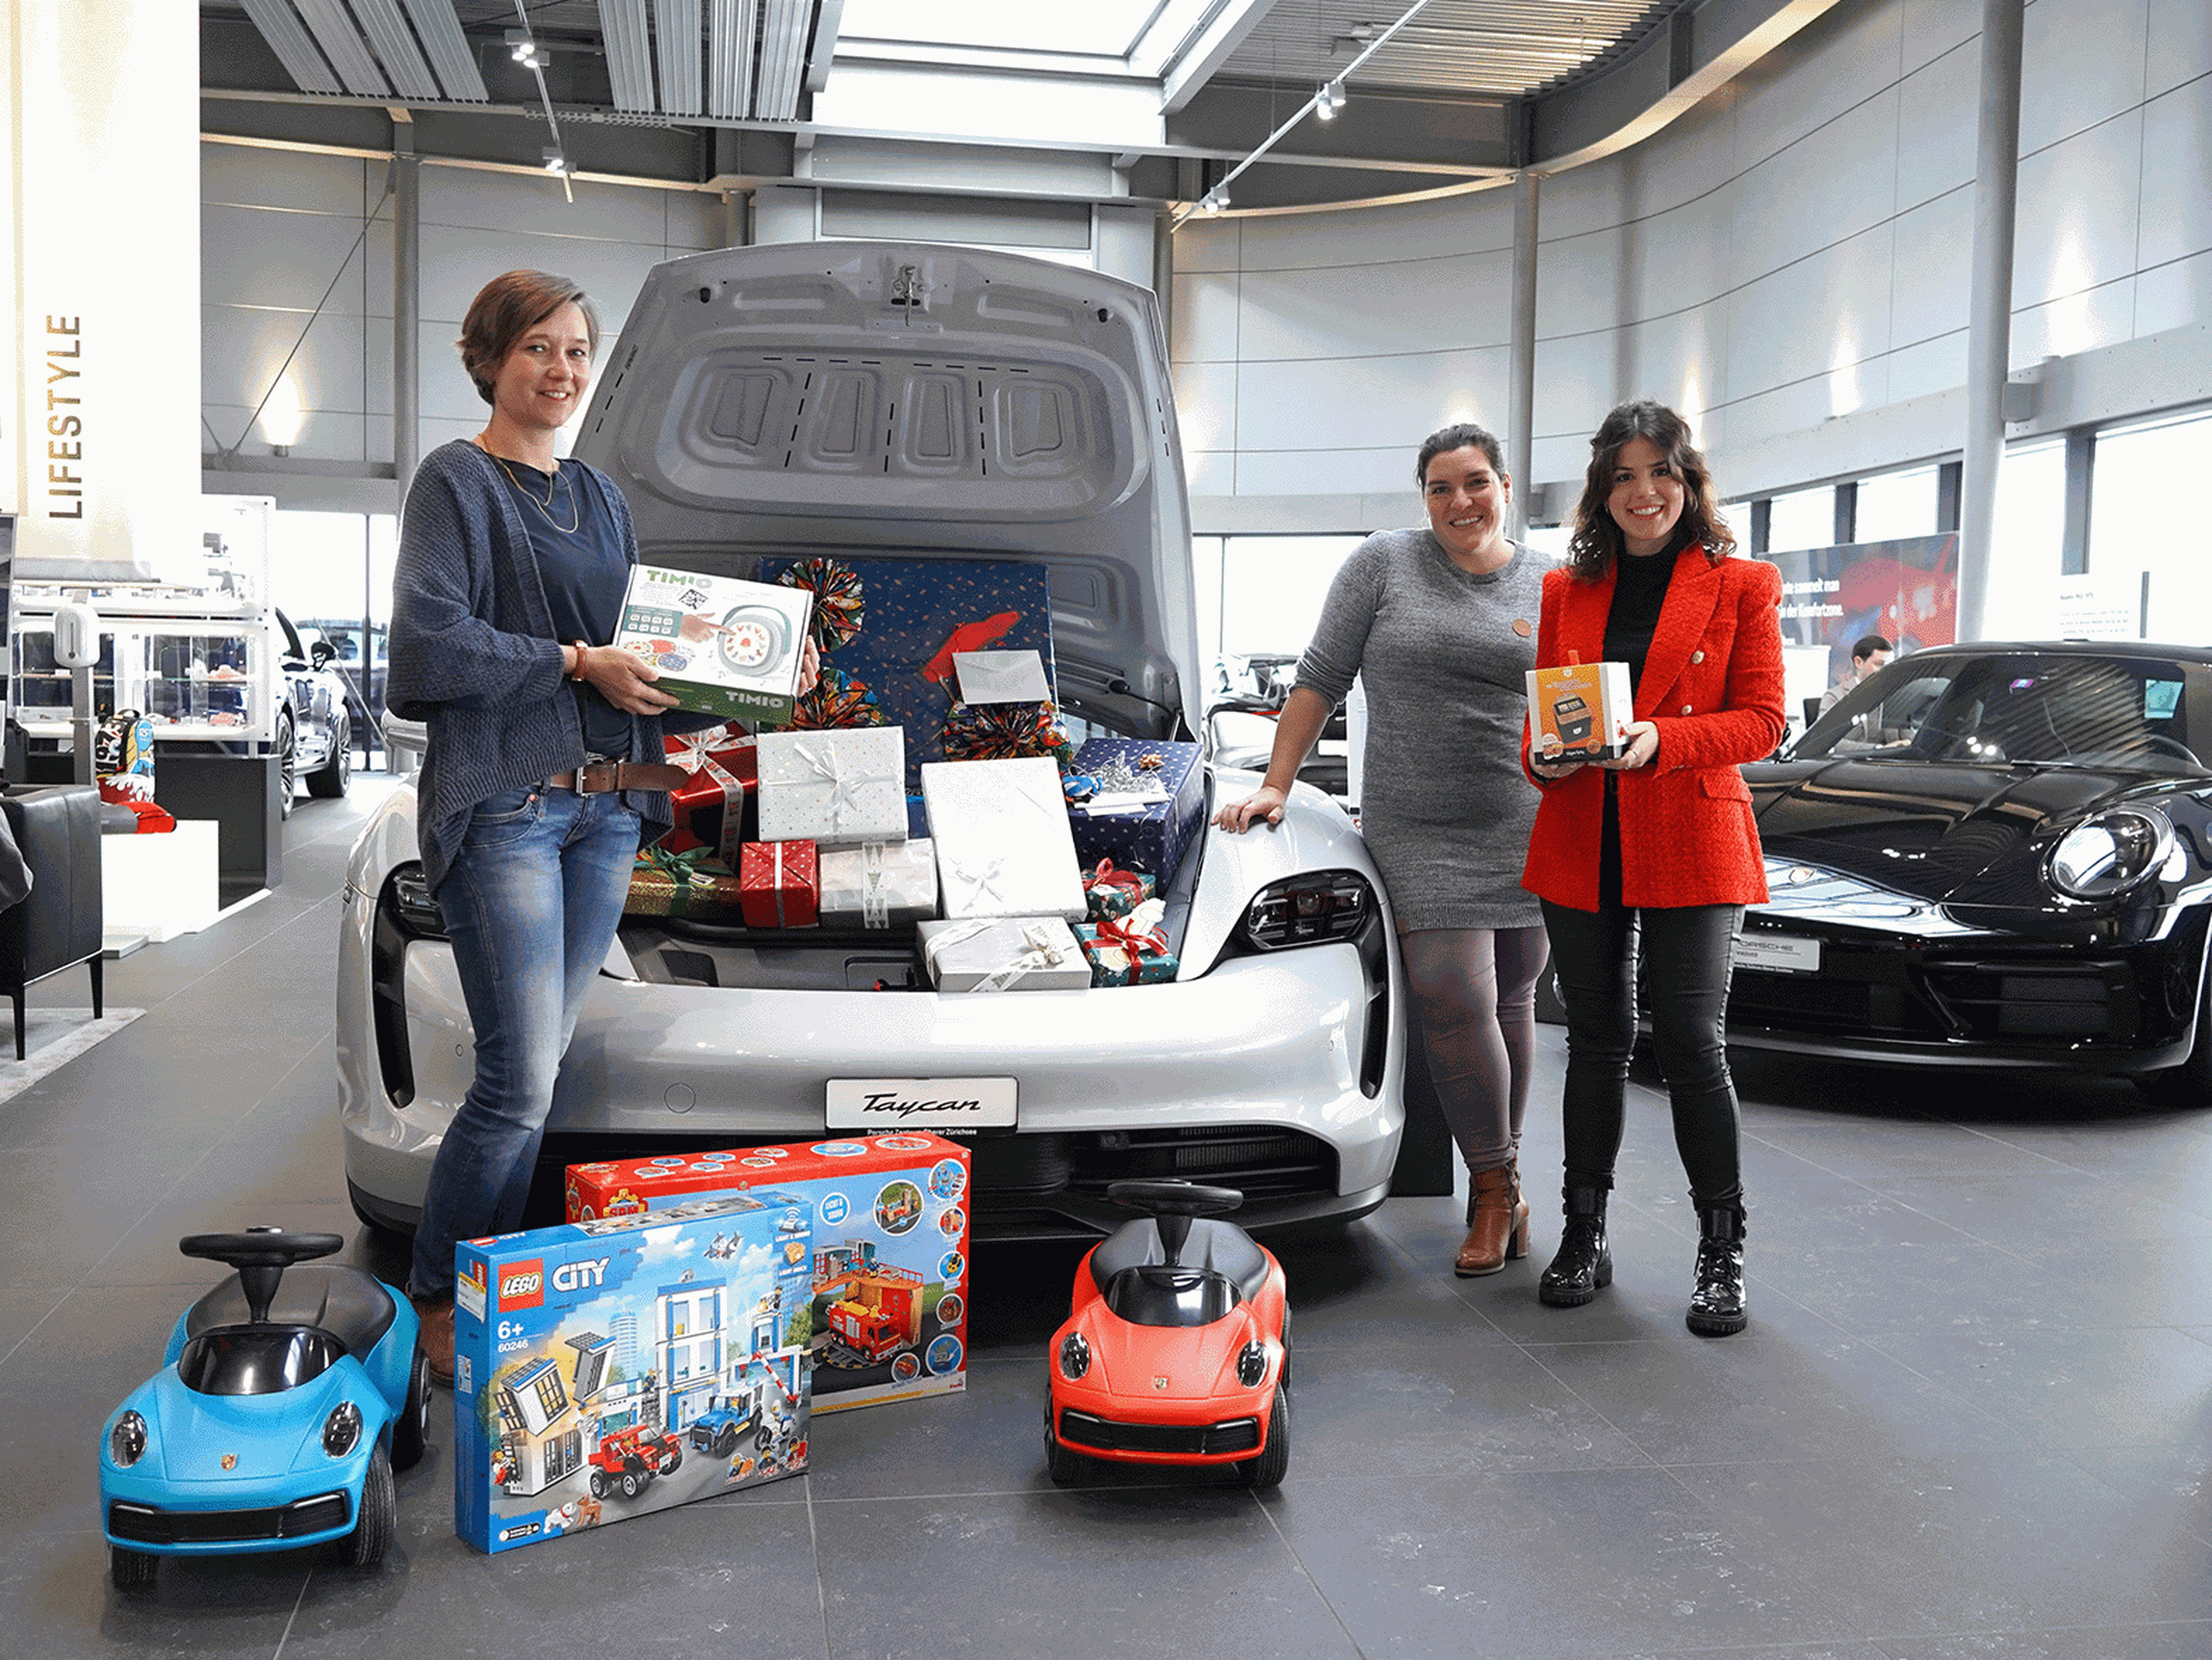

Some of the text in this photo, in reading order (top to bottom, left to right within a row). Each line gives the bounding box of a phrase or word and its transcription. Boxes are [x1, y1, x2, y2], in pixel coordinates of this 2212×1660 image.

[46, 315, 82, 519] LIFESTYLE
[647, 569, 712, 588] TIMIO
[725, 691, 784, 709] TIMIO
[863, 1092, 981, 1119] Taycan
[552, 1256, 611, 1292] CITY
[501, 1273, 541, 1298] LEGO
[498, 1321, 524, 1340] 6+
[498, 1338, 529, 1353] 60246
